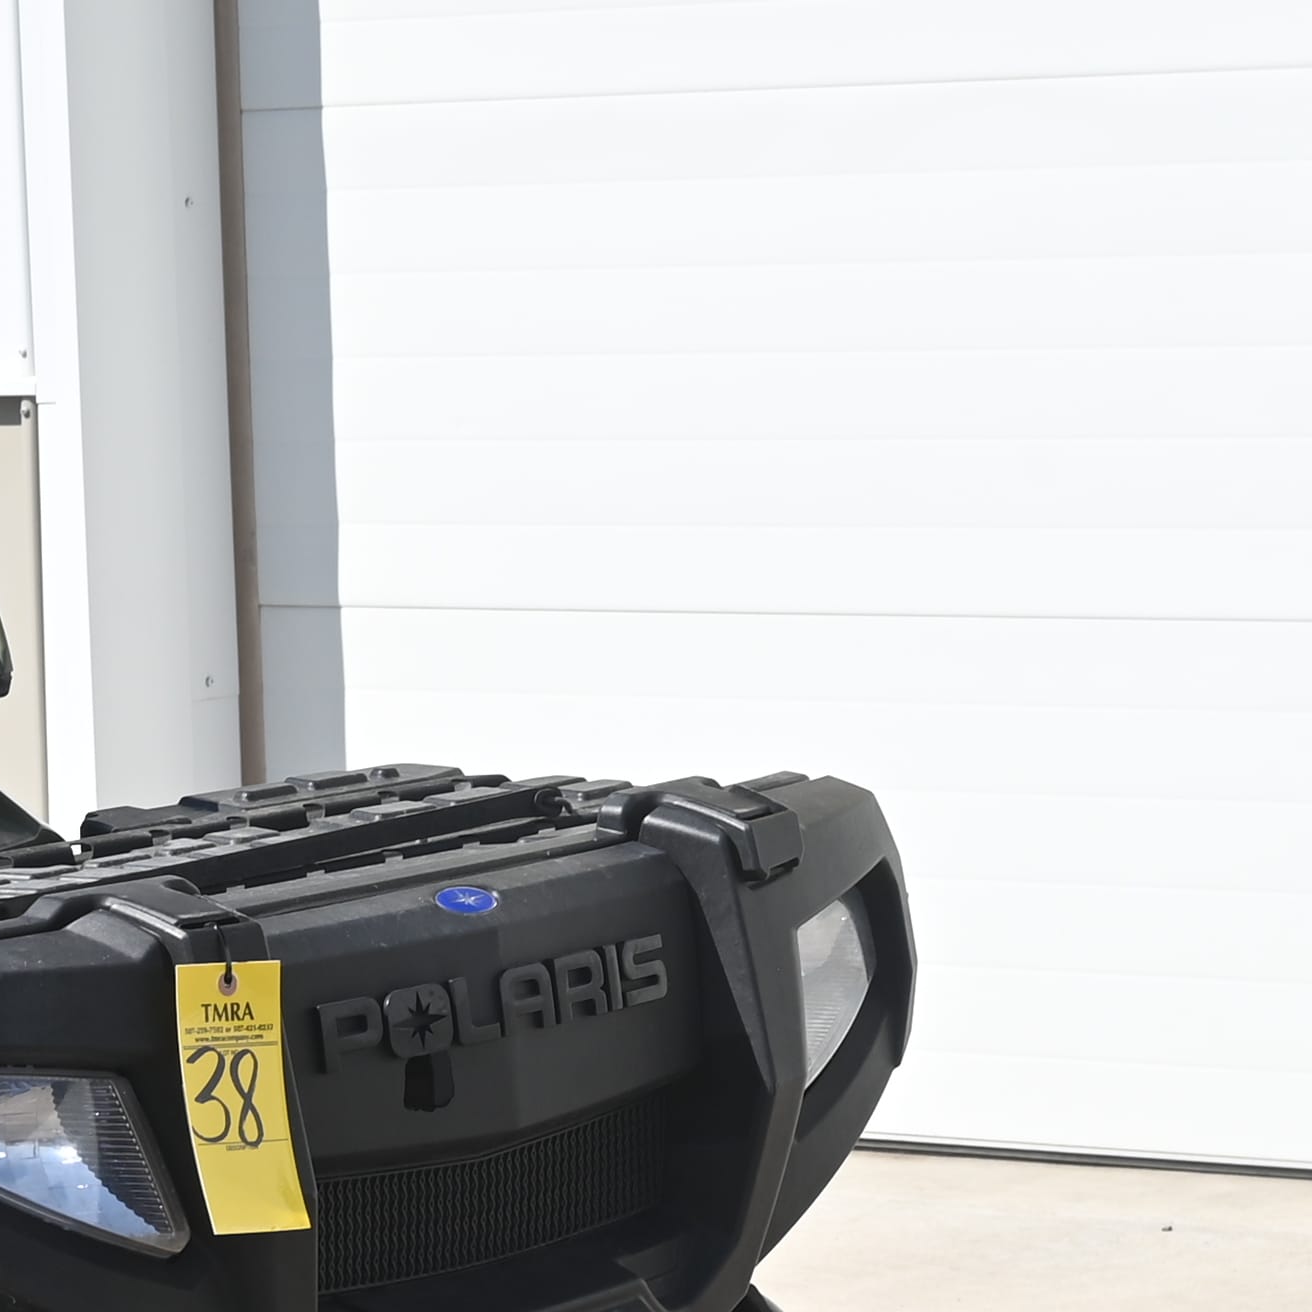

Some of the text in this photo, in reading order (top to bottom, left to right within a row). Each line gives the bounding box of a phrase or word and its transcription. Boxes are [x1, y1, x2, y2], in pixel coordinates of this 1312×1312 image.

[201, 1002, 255, 1023] TMRA
[316, 934, 669, 1073] POLARIS
[186, 1045, 264, 1147] 38
